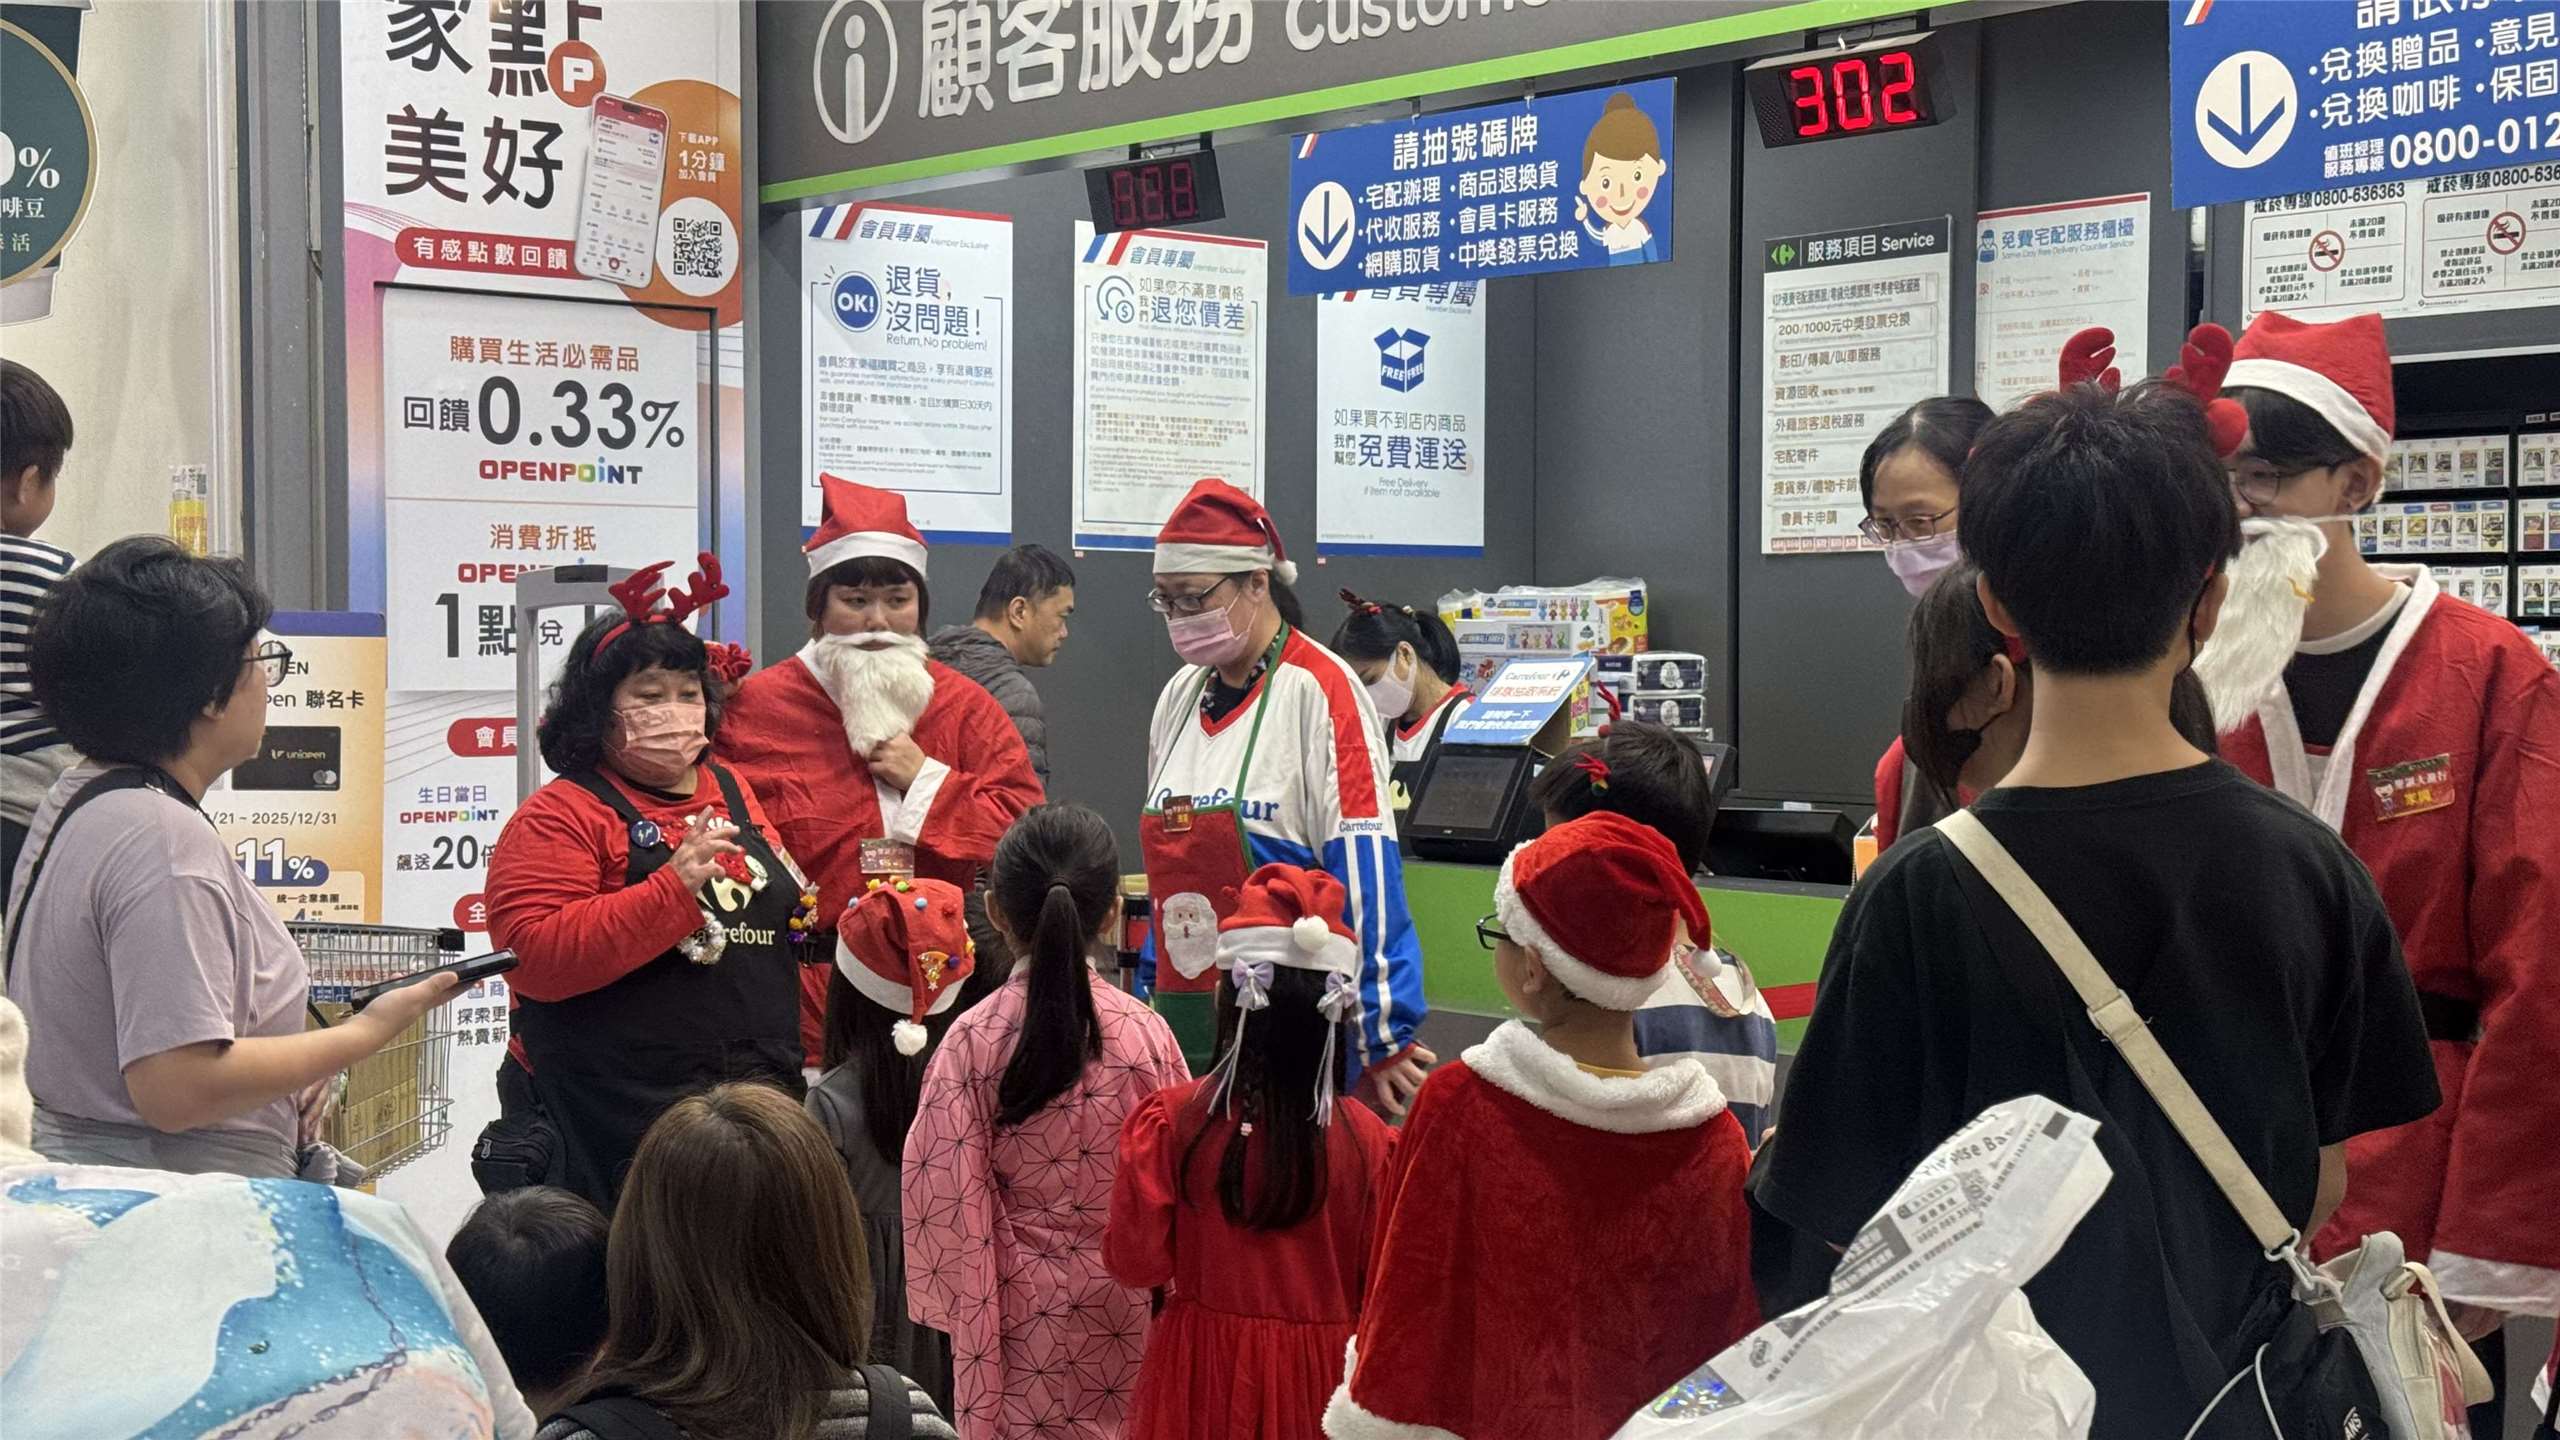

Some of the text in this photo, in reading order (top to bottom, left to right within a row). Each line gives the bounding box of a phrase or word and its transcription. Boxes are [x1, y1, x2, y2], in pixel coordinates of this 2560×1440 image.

[919, 0, 1253, 119] 顧客服務
[2321, 28, 2460, 85] 兌換贈品
[2489, 12, 2560, 56] 意見
[1790, 51, 1918, 137] 302
[2321, 59, 2559, 129] 兌換咖啡 保固
[385, 104, 564, 209] 美好
[1392, 115, 1539, 171] 請抽號碼牌
[2324, 138, 2385, 162] 值班經理
[679, 150, 726, 173] 1分鐘
[2324, 153, 2385, 178] 服務專線
[1366, 160, 1559, 211] 宅配辦理 商品退換貨
[860, 219, 933, 245] 會員專屬
[1366, 197, 1559, 245] 代收服務 會員卡服務
[413, 237, 568, 271] 有感點數回饋
[1129, 246, 1196, 270] 會員專屬
[1365, 231, 1579, 279] 網購取貨 中獎發票兌換
[1807, 232, 1934, 263] 服務項目 Service
[1139, 277, 1245, 302] 如果您不滿意價格
[837, 292, 875, 315] OK!
[1151, 296, 1246, 331] 退您價差
[450, 336, 640, 372] 購買生活必需品
[1381, 363, 1424, 382] FREE FREE
[404, 375, 685, 450] 回饋 0.33%
[1334, 408, 1466, 433] 如果買不到店內商品
[1334, 434, 1356, 449] 我們
[1358, 434, 1467, 471] 免費運送
[1774, 448, 1819, 464] 宅配寄件
[1781, 510, 1838, 527] 會員卡申請
[490, 524, 597, 552] 消費折抵
[305, 689, 365, 709] 聯名卡
[418, 785, 488, 804] 生日當日
[252, 811, 337, 825] 2025/12/31
[1339, 820, 1384, 832] Carrefour
[235, 838, 315, 881] 11%
[277, 893, 340, 904] 統一企業集團
